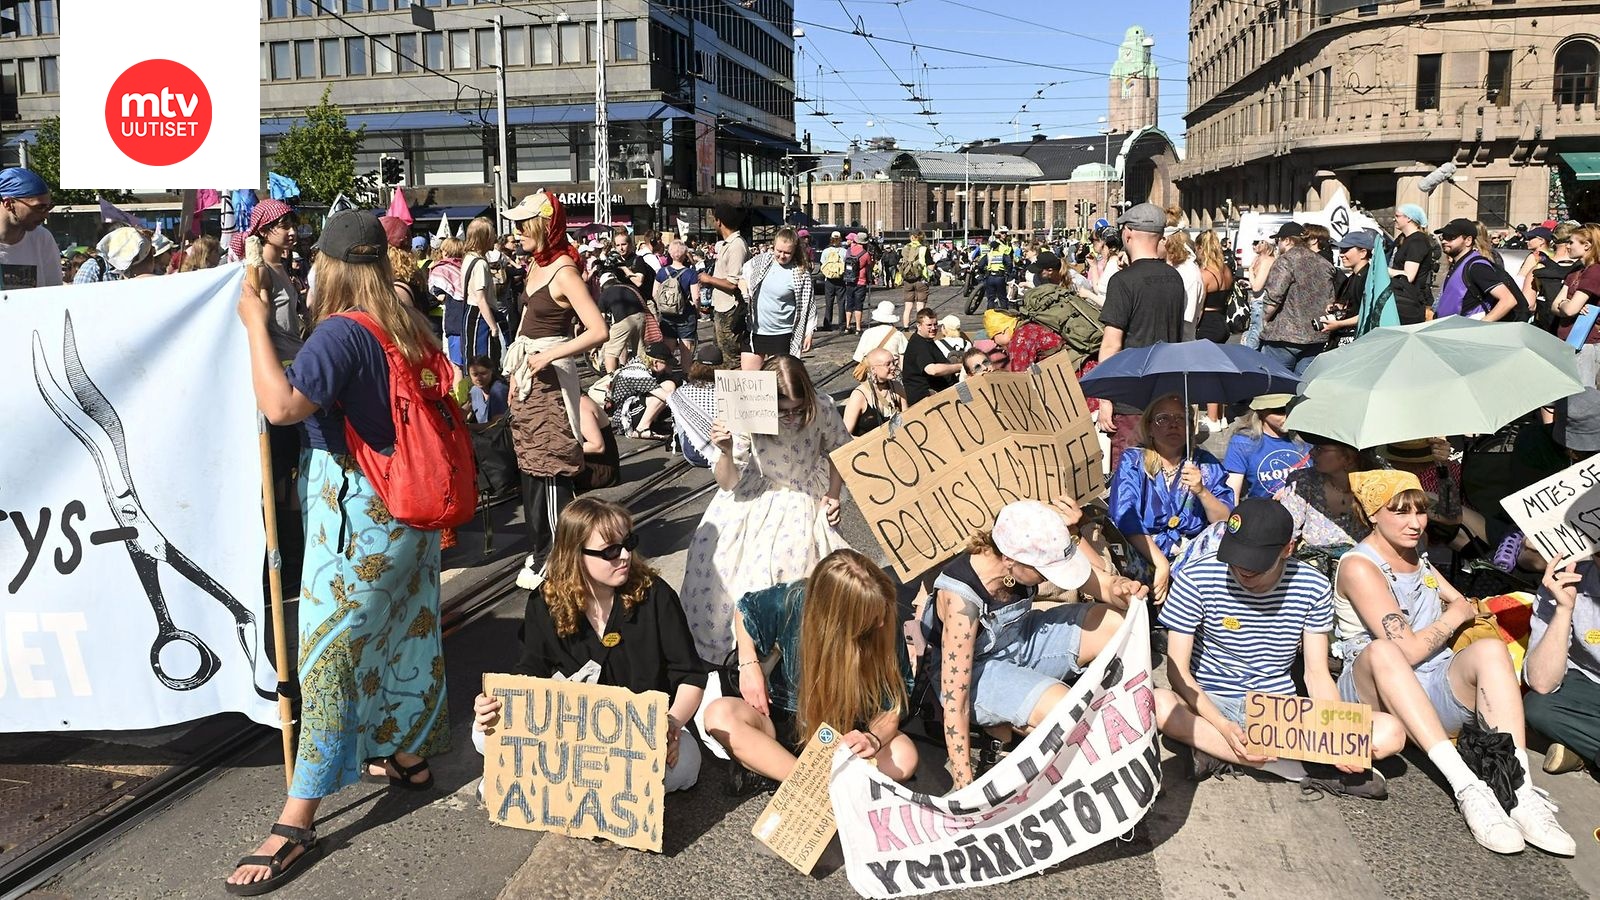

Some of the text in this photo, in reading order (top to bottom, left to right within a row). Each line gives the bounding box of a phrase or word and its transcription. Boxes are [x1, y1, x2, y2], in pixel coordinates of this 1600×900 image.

[717, 376, 764, 393] MILJARDIT
[851, 364, 1080, 505] SORTO KUKKII
[876, 471, 997, 573] POLIISI
[1522, 480, 1576, 518] MITES
[492, 688, 657, 750] TUHON
[1249, 694, 1362, 726] STOP green
[501, 736, 646, 793] TUET
[1248, 723, 1370, 758] COLONIALISM
[497, 781, 639, 838] ALAS
